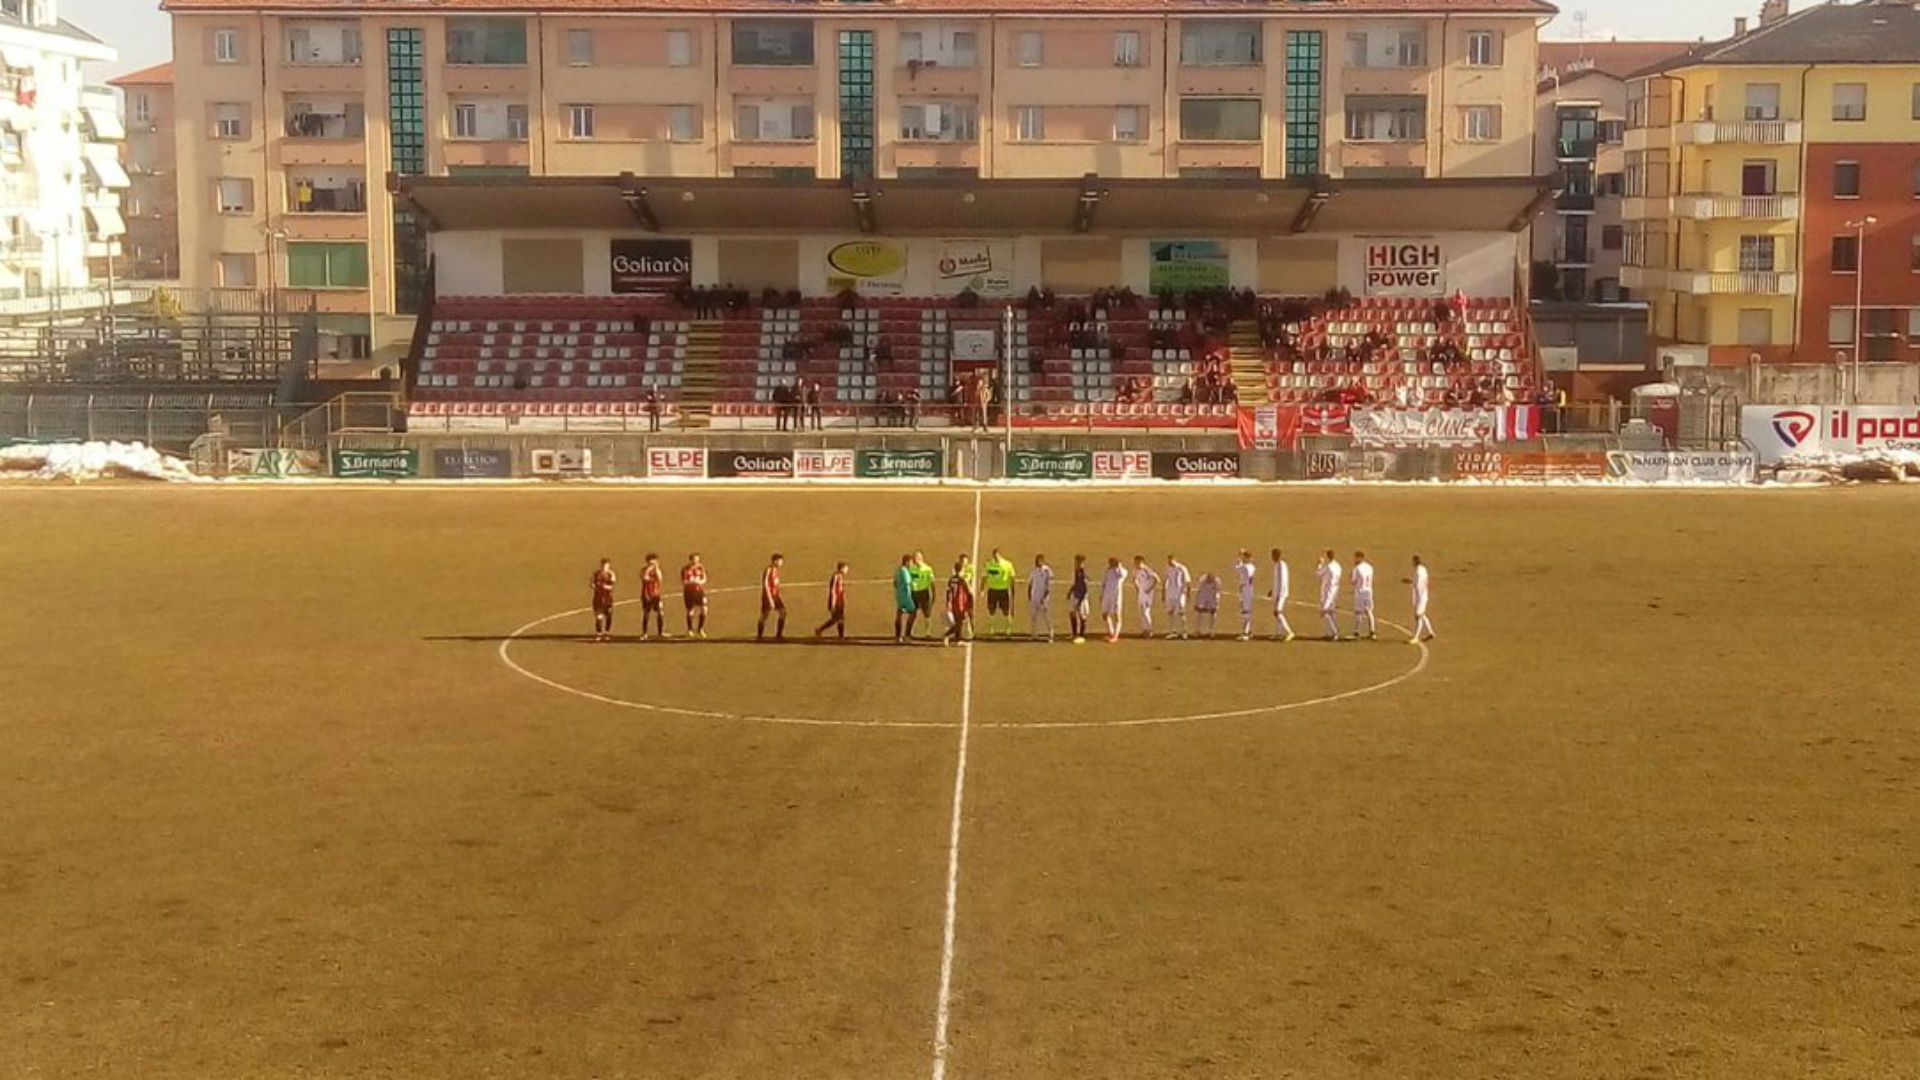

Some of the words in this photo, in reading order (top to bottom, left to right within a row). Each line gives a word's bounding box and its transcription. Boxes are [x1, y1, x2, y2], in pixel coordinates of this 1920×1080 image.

[613, 255, 689, 273] Goliardi
[1369, 244, 1440, 267] HIGH
[1831, 410, 1848, 438] il
[650, 451, 704, 468] ELPE
[733, 456, 793, 470] Goliard
[1094, 454, 1149, 471] ELPE
[1175, 456, 1238, 472] Goliardi
